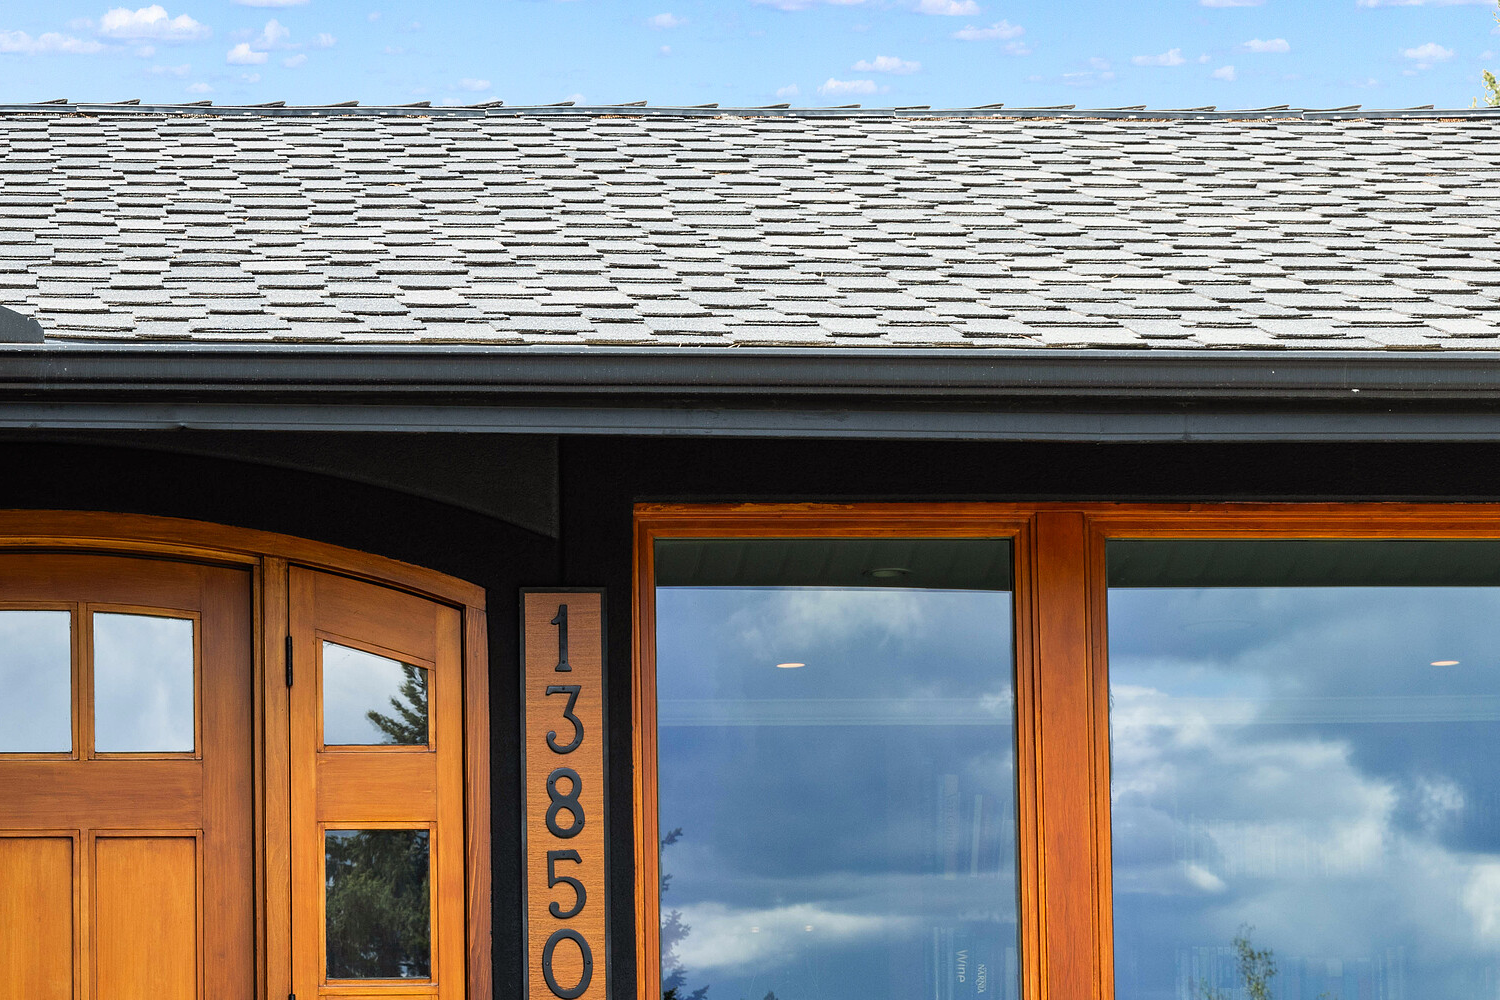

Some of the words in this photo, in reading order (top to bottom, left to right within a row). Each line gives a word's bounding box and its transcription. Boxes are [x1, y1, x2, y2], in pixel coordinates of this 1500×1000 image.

[542, 603, 593, 1000] 13850
[956, 949, 969, 983] Wine
[976, 963, 986, 994] NARNIA
